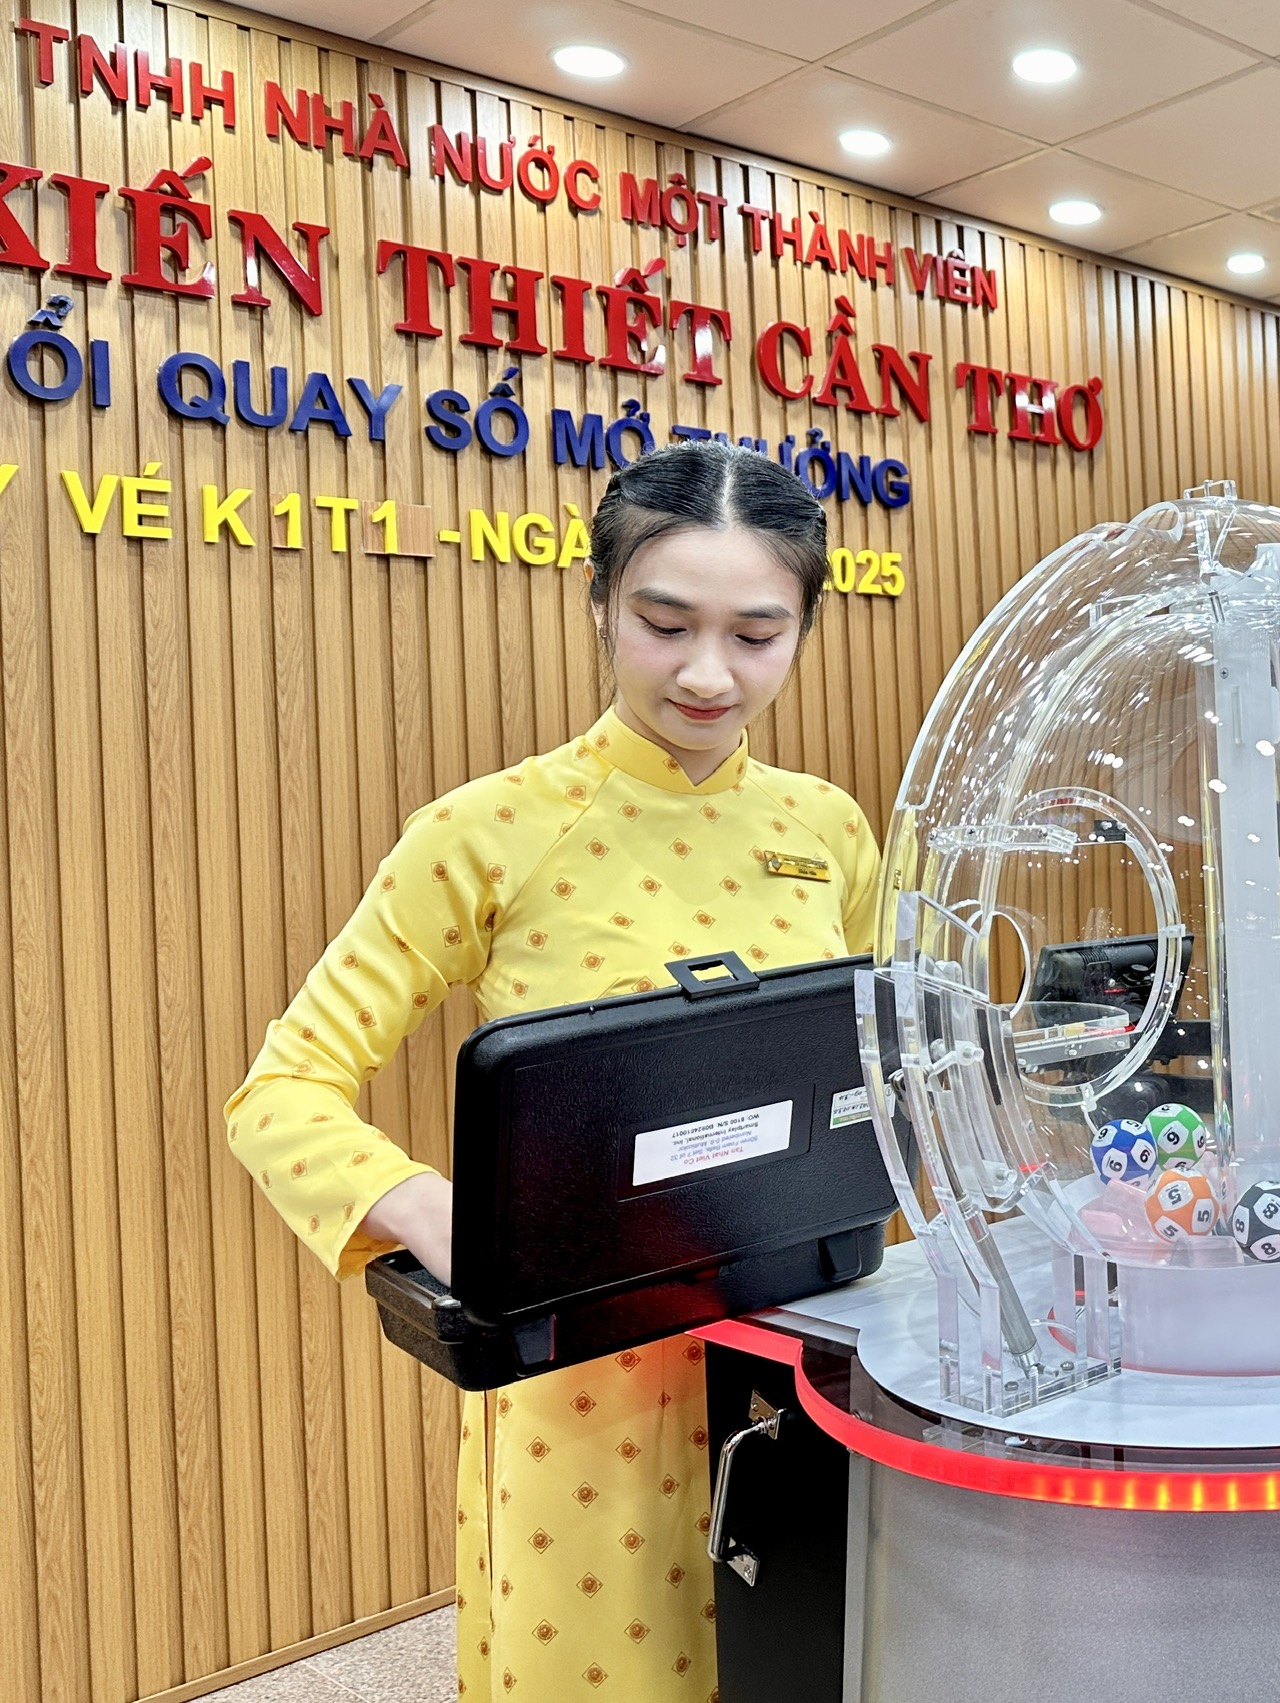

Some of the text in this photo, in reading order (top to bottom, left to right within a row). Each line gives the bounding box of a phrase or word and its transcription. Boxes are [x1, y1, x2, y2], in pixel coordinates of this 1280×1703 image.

[19, 18, 999, 310] TNHH NHÀ NƯỚC MỘT THÀNH VIÊN
[377, 239, 732, 386] THIẾT
[757, 295, 933, 423] CẦN
[955, 362, 1104, 452] THƠ
[156, 350, 403, 441] QUAY
[425, 367, 530, 458] SỐ
[551, 398, 655, 471] MỞ
[62, 462, 173, 540] VÉ
[822, 547, 905, 596] 025
[728, 1122, 758, 1132] Smartplay
[712, 1150, 729, 1158] Nhat
[1168, 1188, 1181, 1205] 5
[1197, 1210, 1210, 1222] 5
[1263, 1203, 1278, 1219] 8
[1163, 1225, 1178, 1237] 5
[1236, 1219, 1244, 1232] 8
[1261, 1243, 1276, 1255] 8
